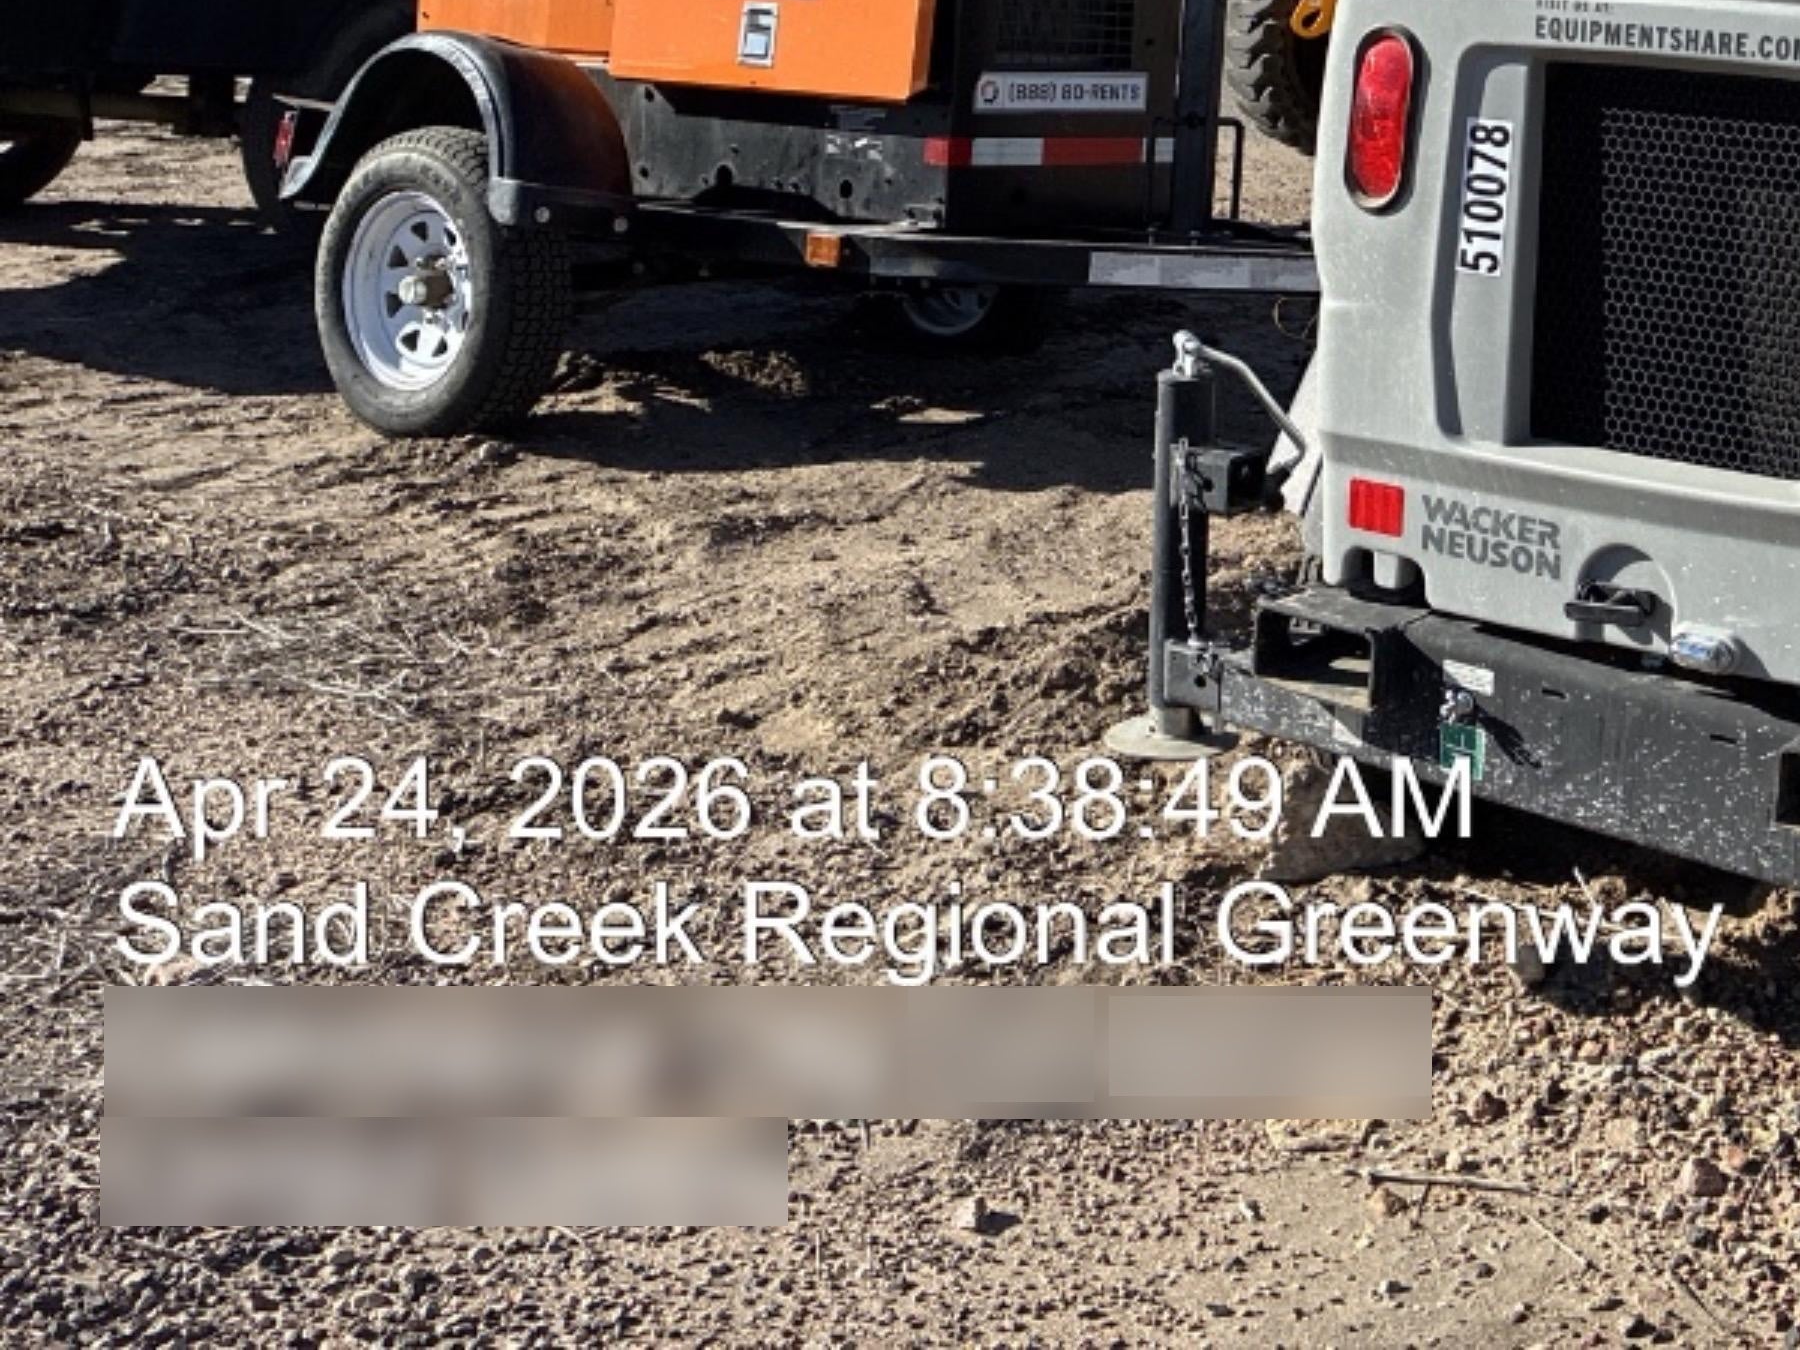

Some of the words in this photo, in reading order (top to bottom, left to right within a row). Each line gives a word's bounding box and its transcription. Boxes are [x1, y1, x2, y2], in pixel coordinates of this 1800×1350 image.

[1460, 124, 1511, 274] 510078
[1421, 493, 1561, 549] WACKER
[1422, 524, 1561, 580] NEUSON
